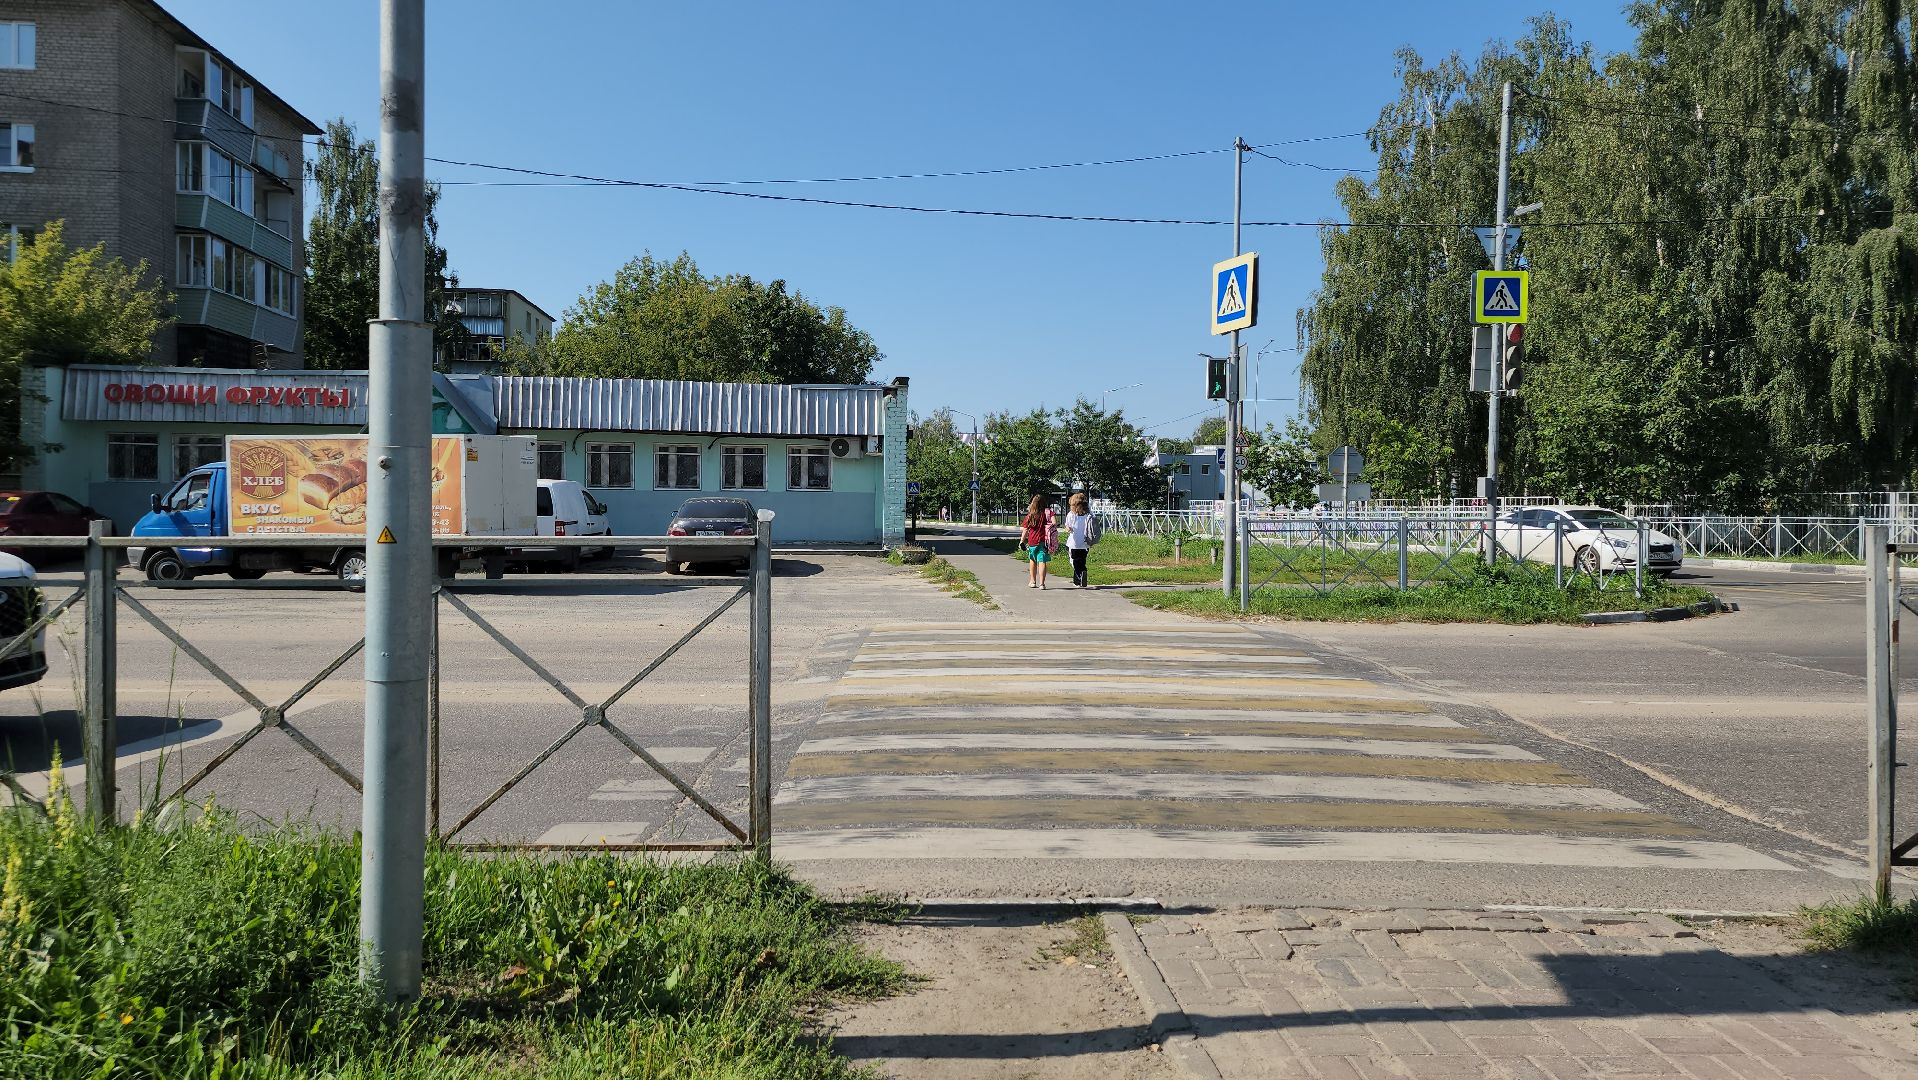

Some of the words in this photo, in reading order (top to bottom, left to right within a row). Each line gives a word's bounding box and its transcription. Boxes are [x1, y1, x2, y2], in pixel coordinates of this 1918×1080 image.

[103, 383, 218, 408] ОВОЩИ
[225, 385, 350, 408] ФРУКТЫ
[1235, 458, 1245, 466] 40
[242, 476, 284, 486] ХЛЕБ
[240, 503, 281, 515] ВКУС
[256, 516, 314, 524] ЗНАКОМЫЙ
[247, 525, 255, 533] С
